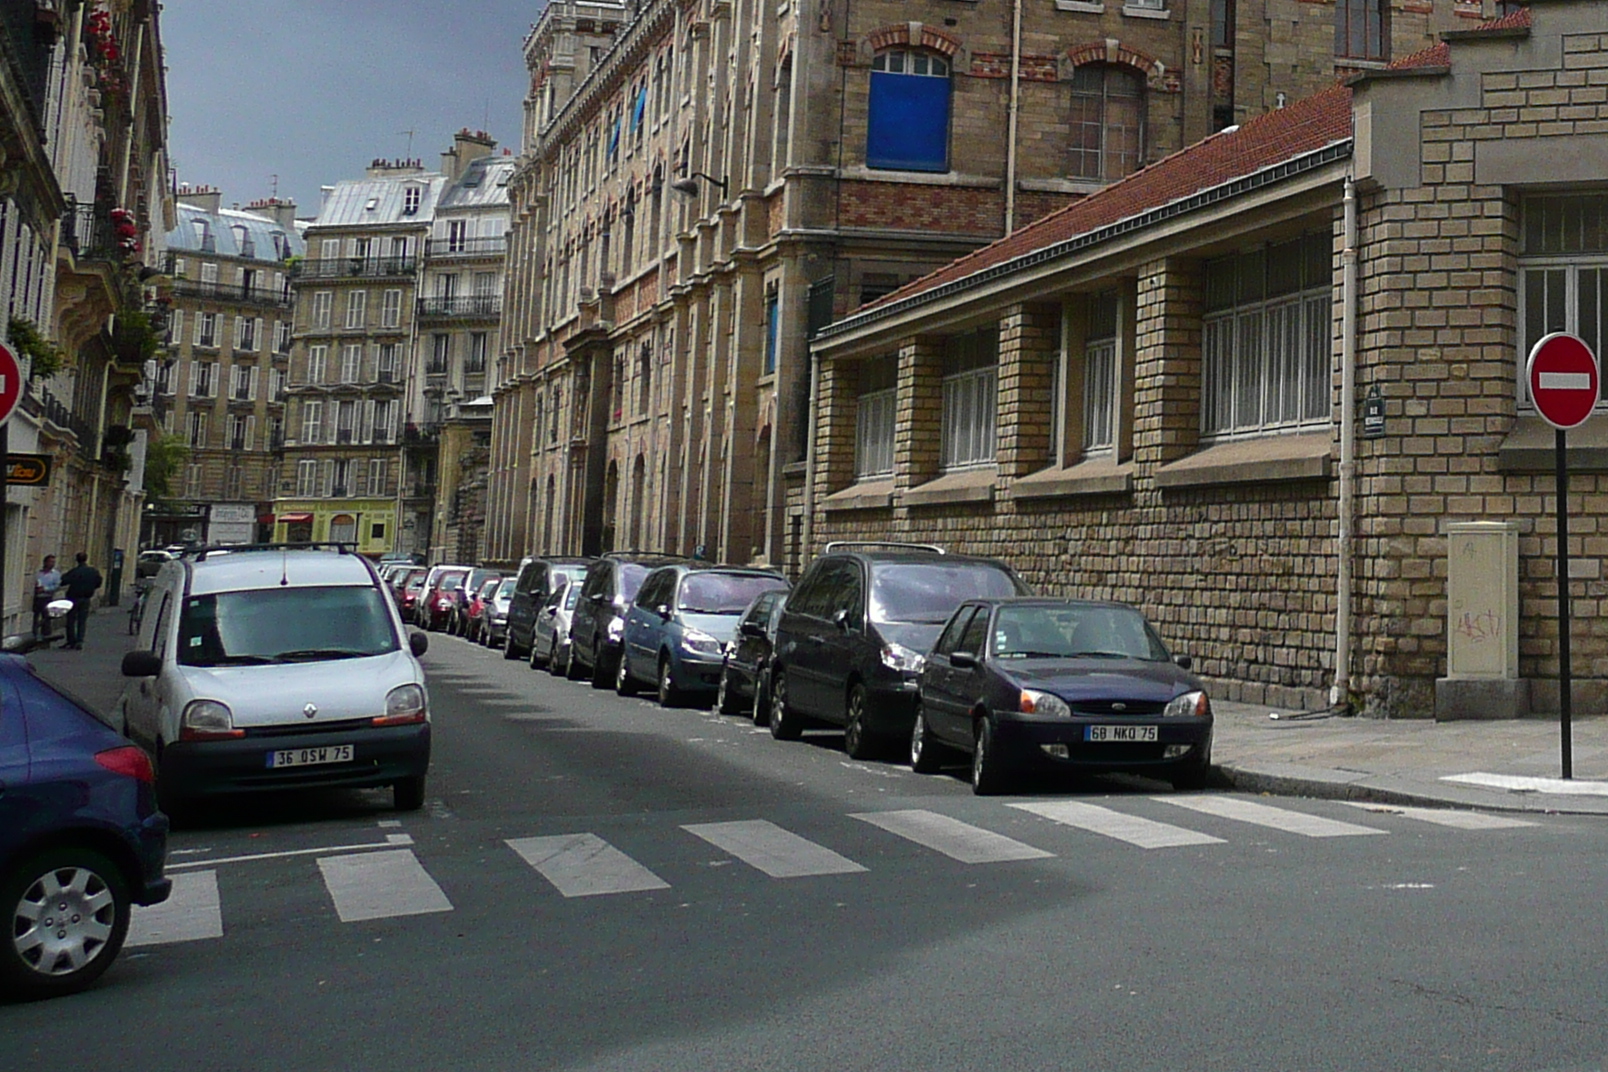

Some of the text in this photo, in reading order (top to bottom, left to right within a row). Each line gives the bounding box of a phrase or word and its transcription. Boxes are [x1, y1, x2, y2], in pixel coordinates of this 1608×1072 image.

[1141, 727, 1156, 740] 75
[278, 751, 293, 765] 36
[334, 746, 350, 760] 75
